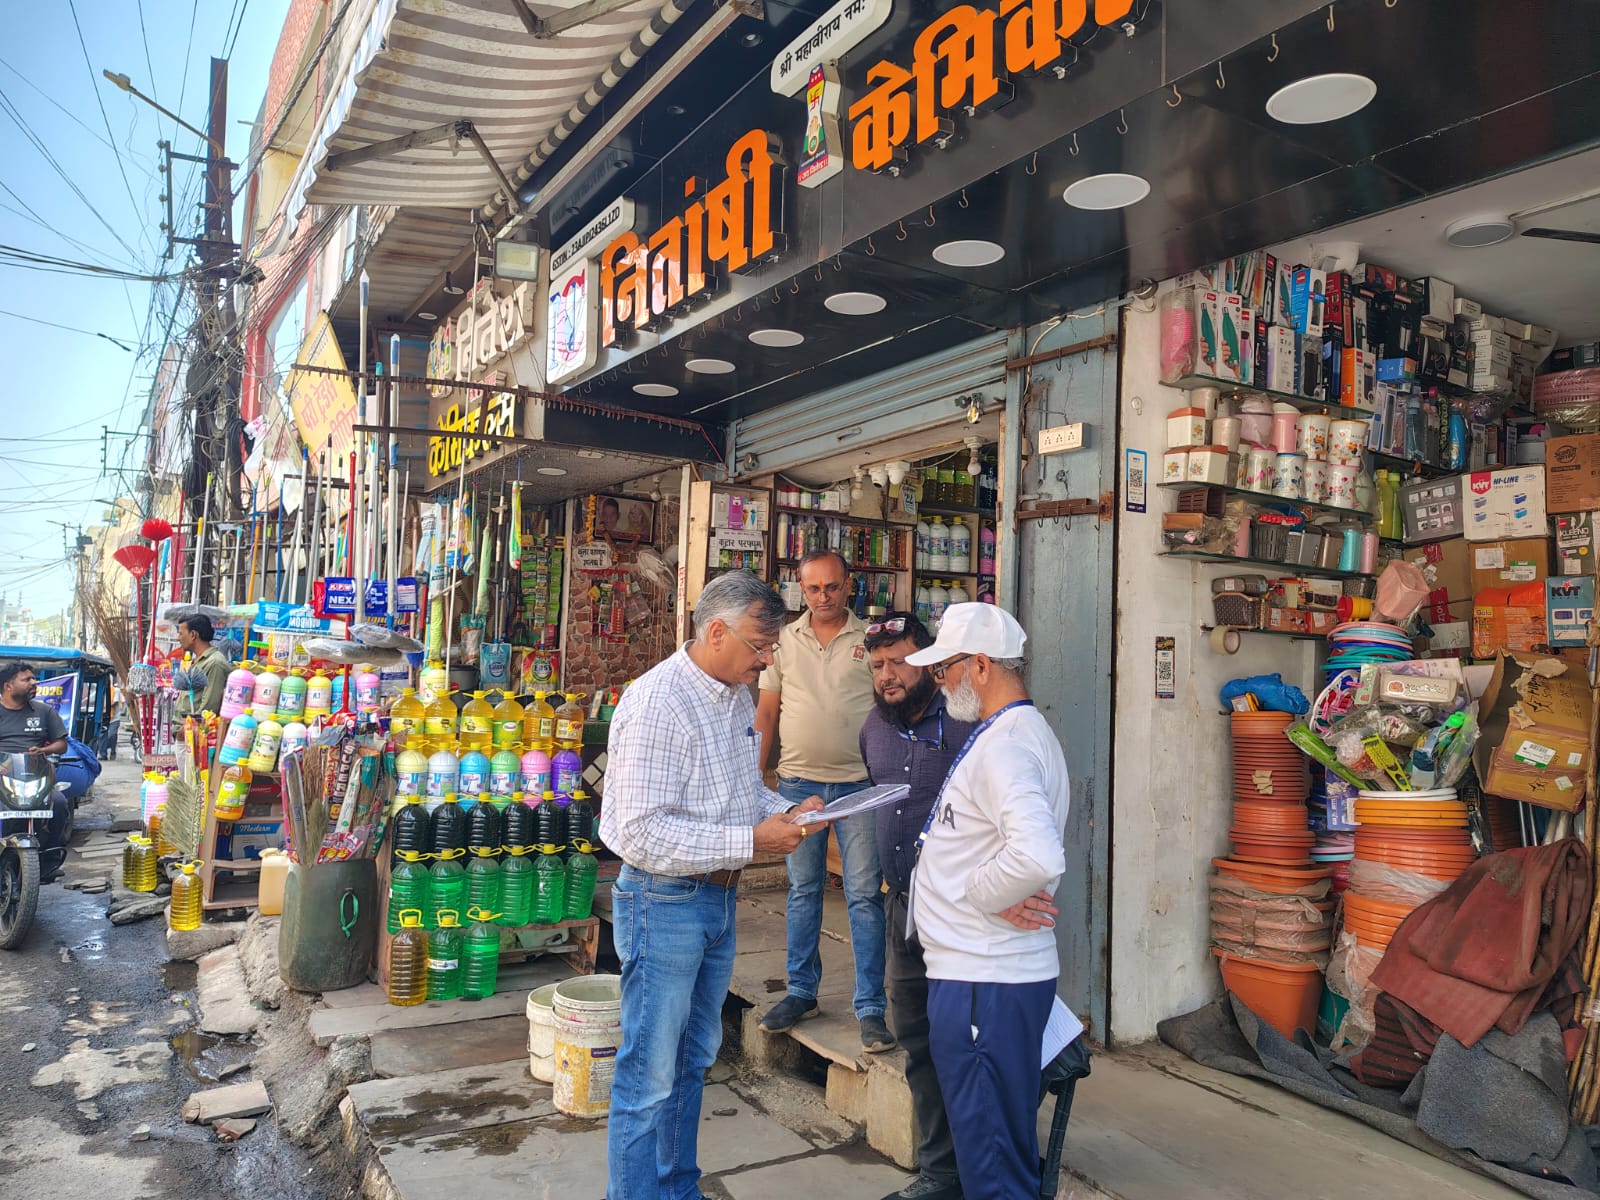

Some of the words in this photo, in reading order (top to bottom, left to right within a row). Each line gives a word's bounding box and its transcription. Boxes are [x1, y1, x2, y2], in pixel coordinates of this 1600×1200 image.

[780, 52, 792, 77] श्री
[795, 25, 841, 62] महावीराय
[1552, 585, 1580, 597] KVT
[36, 686, 63, 697] 2026
